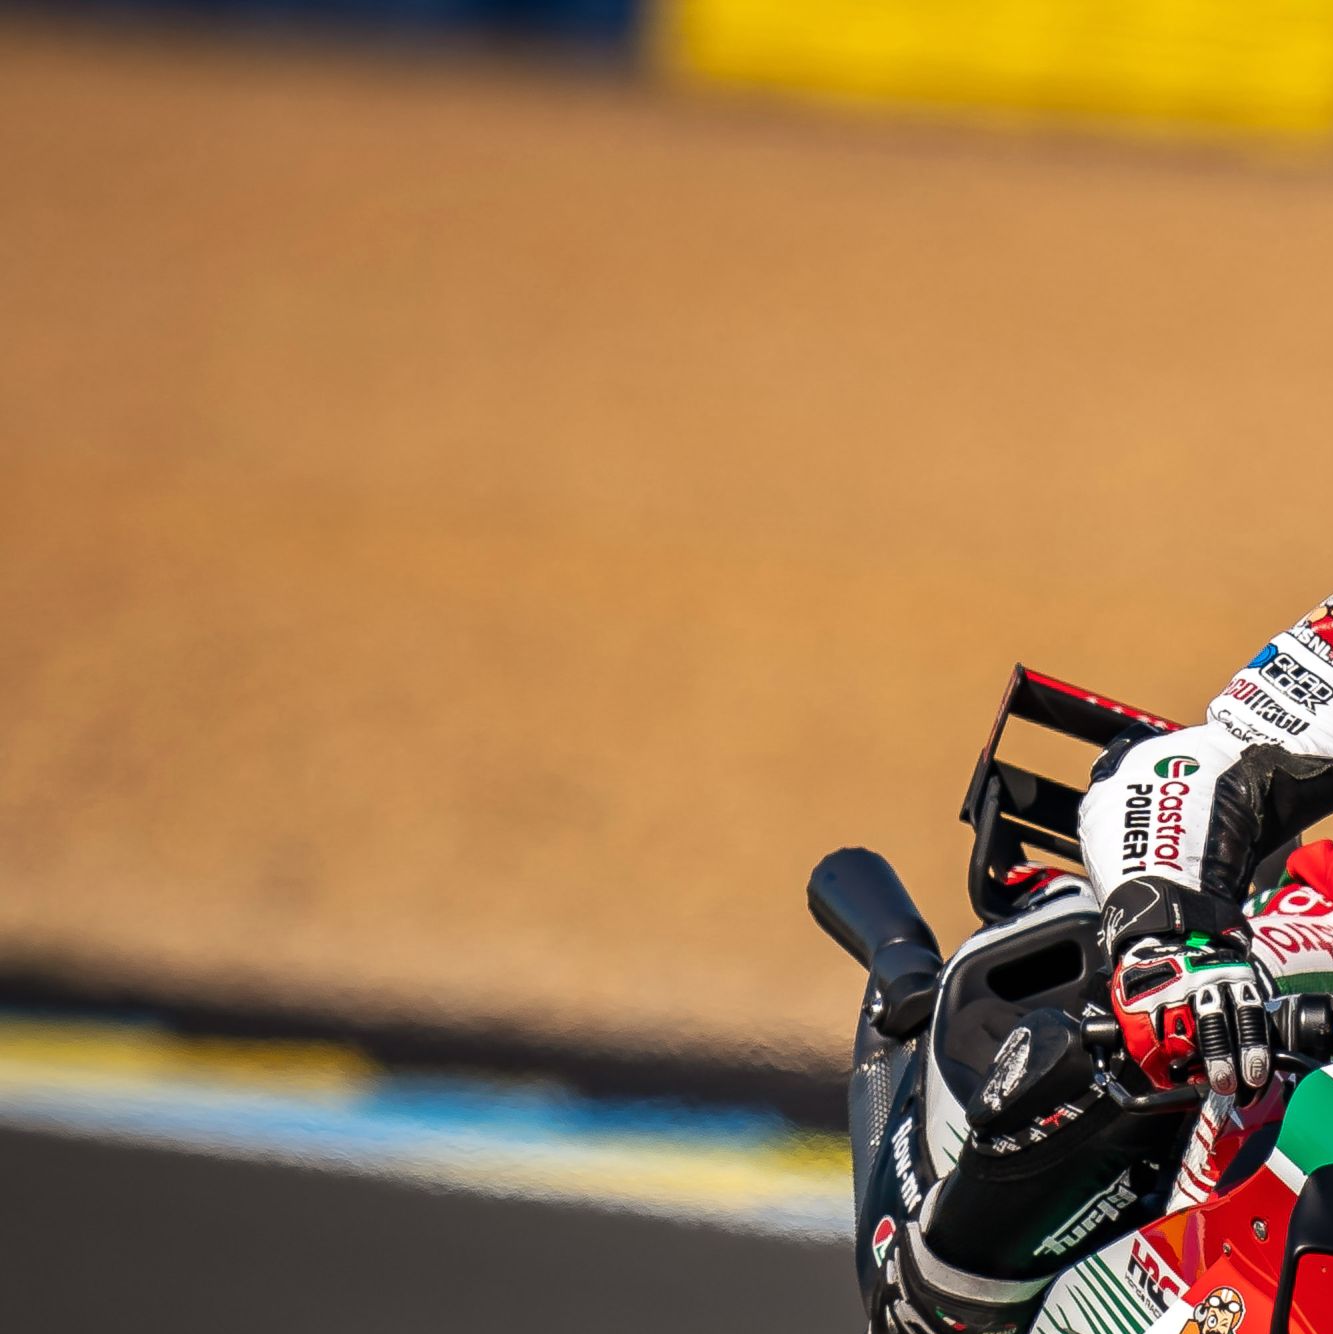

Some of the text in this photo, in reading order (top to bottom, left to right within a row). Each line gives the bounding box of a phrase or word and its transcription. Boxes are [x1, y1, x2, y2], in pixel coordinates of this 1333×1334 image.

[1261, 662, 1328, 714] LOCK
[1276, 654, 1333, 700] QUAD
[1122, 784, 1153, 875] POWER1
[1154, 781, 1190, 872] Castrol
[1126, 1238, 1181, 1316] HRC
